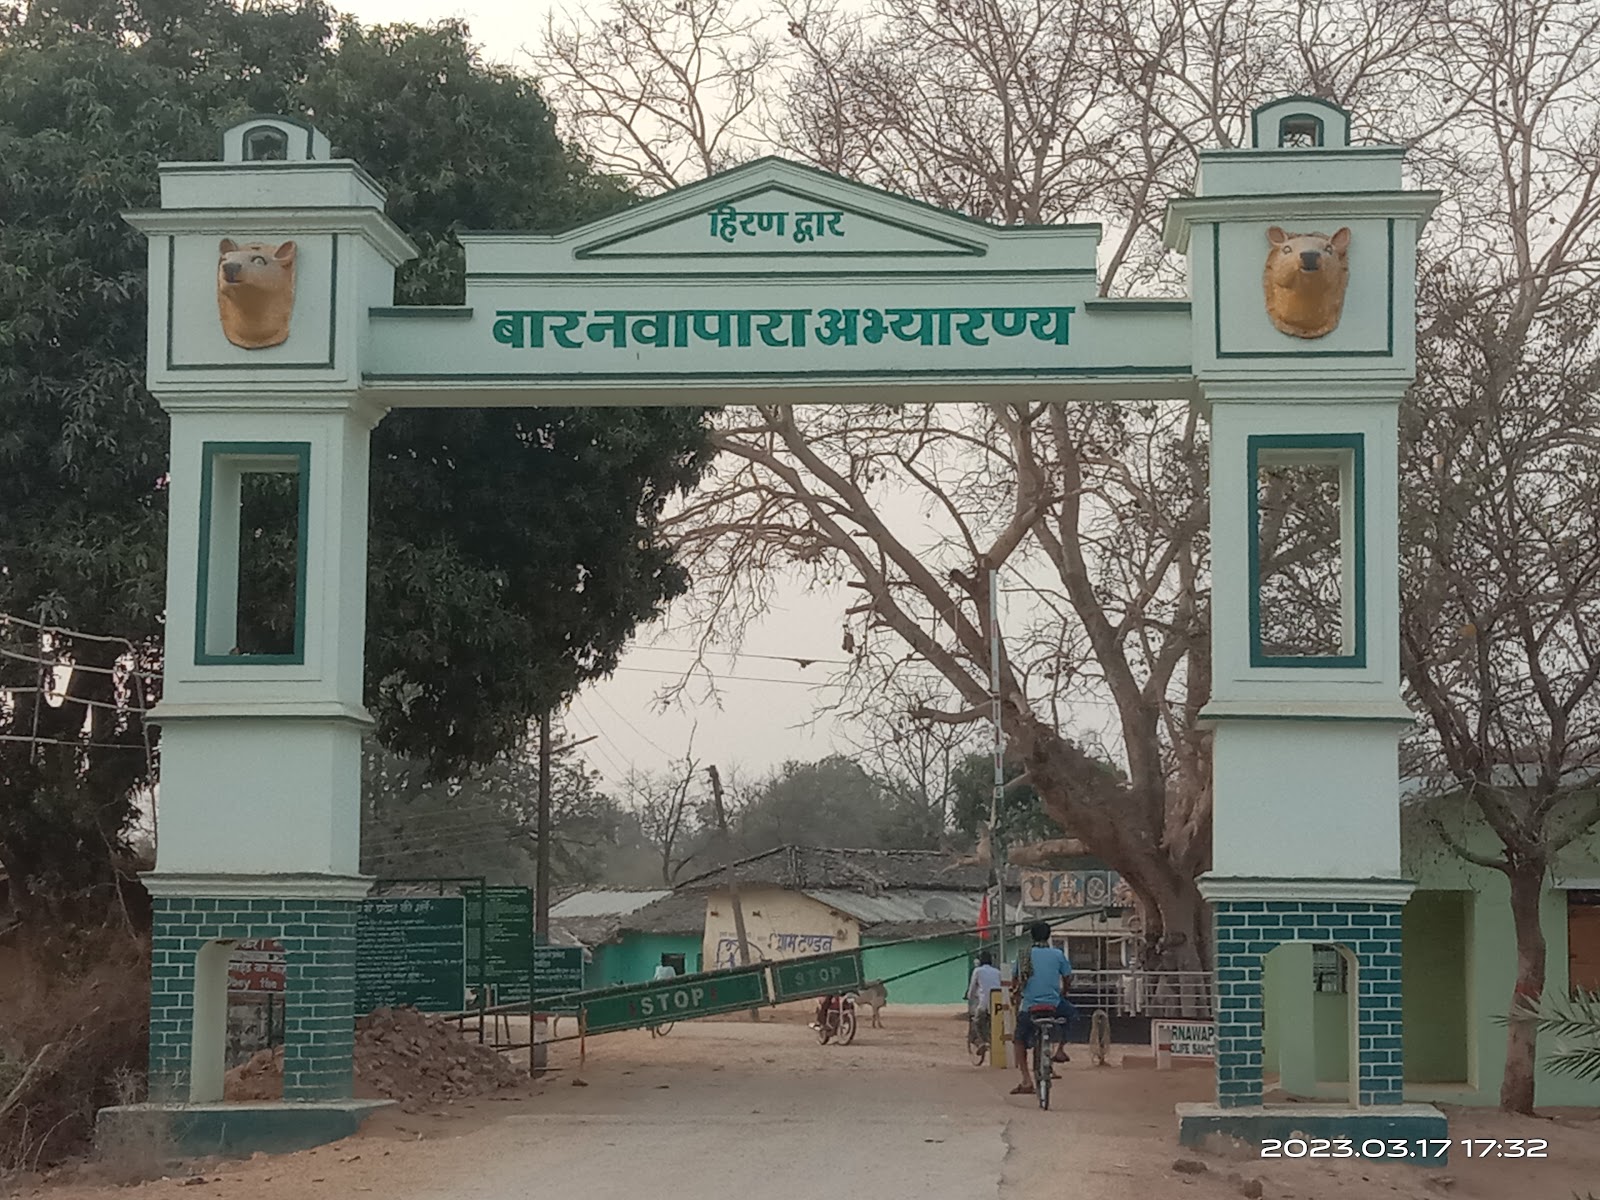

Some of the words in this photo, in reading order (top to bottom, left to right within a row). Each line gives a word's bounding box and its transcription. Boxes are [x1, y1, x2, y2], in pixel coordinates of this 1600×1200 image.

[709, 205, 788, 242] हिरण
[790, 211, 845, 243] द्वार
[793, 966, 841, 985] STOP
[641, 988, 704, 1014] STOP
[1159, 1025, 1215, 1042] RNAWAP
